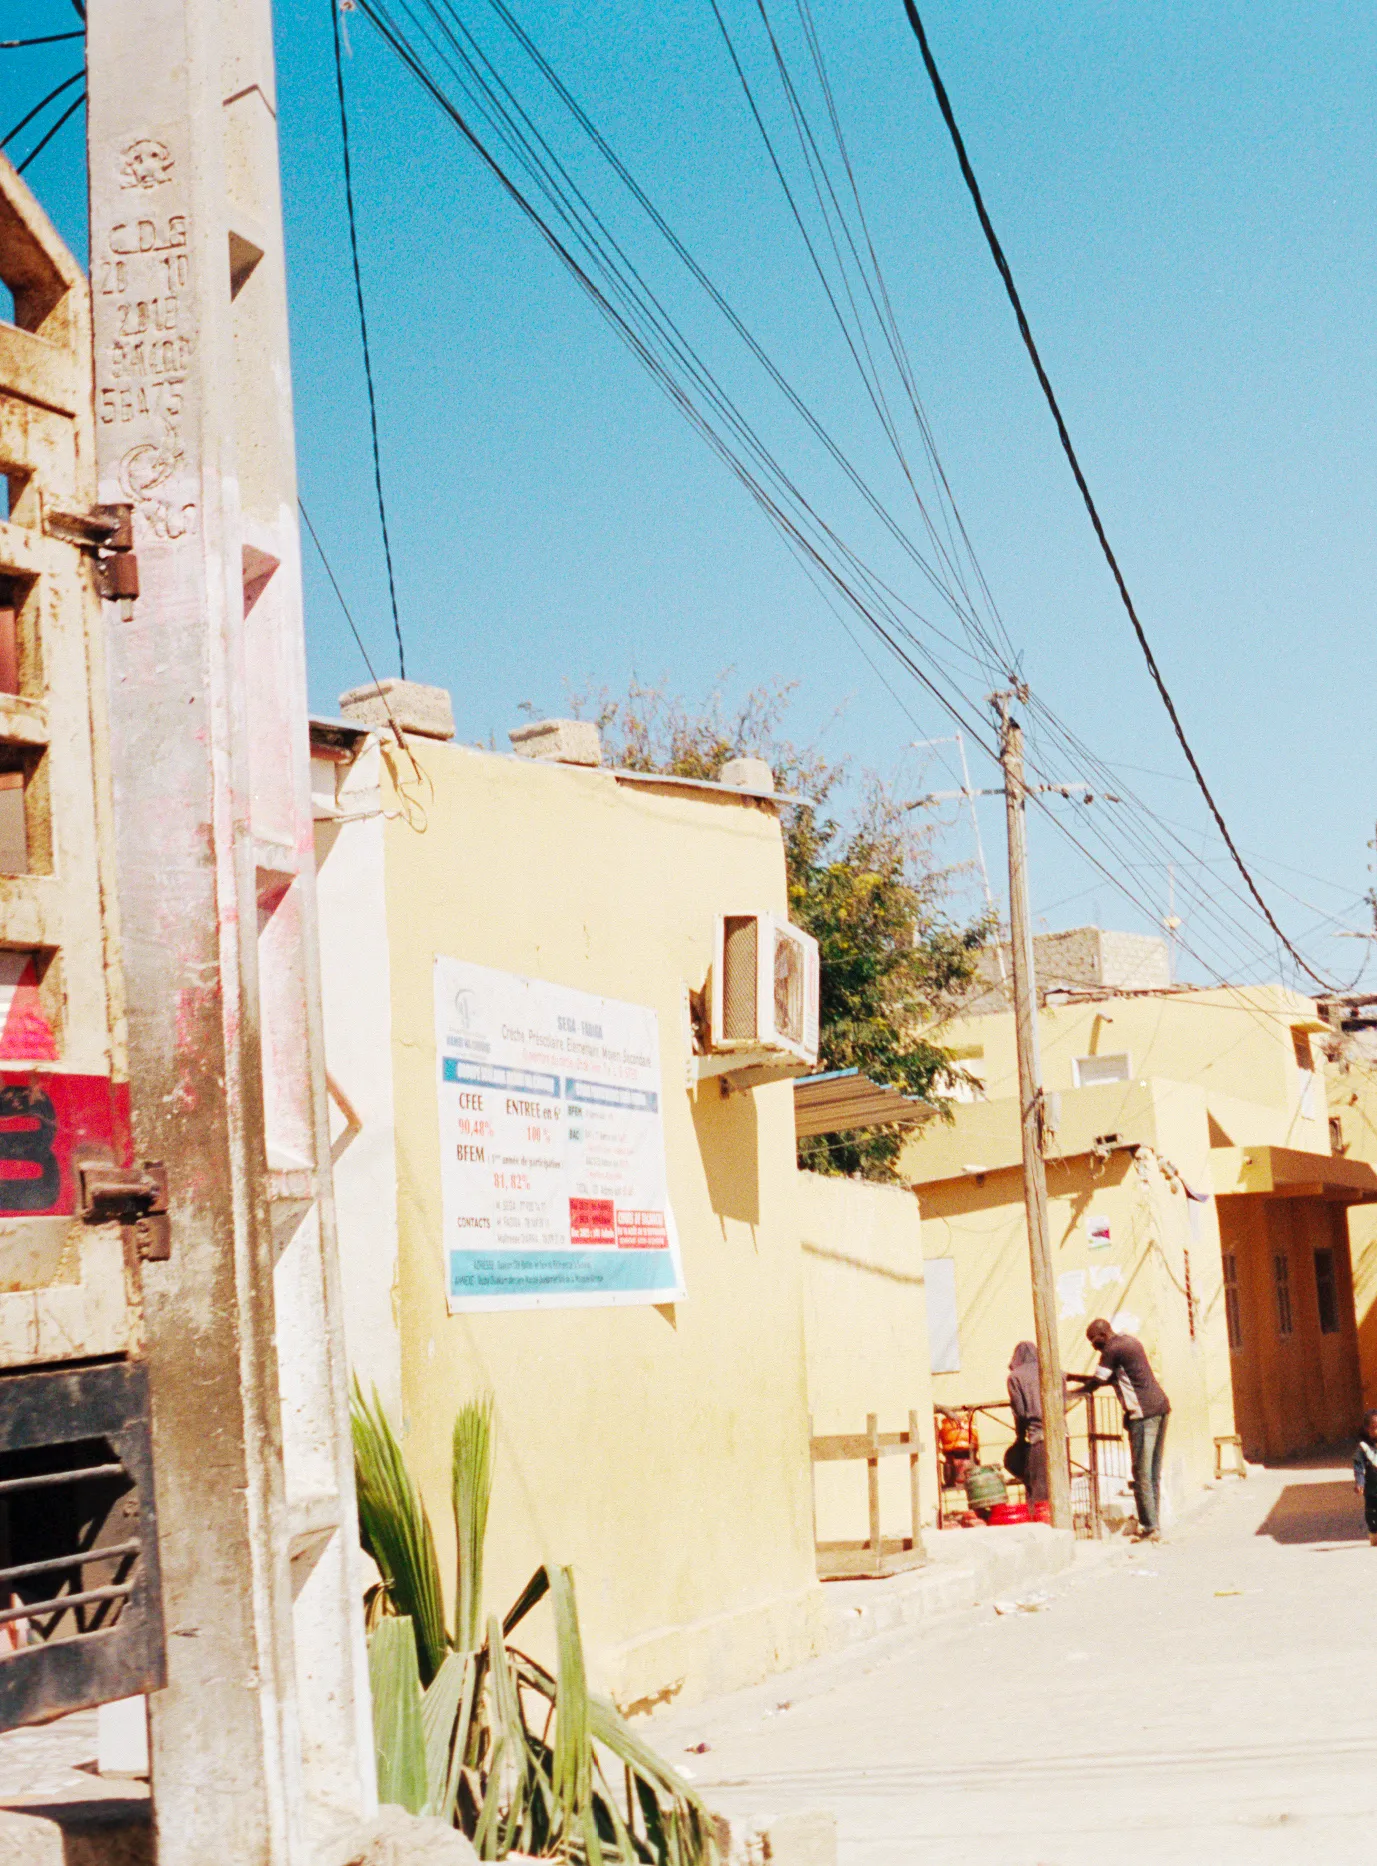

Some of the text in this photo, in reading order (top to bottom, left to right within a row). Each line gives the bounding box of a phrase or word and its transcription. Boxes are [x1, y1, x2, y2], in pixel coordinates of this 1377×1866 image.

[459, 1092, 484, 1111] CFEE
[457, 1144, 485, 1163] BFEM
[457, 1216, 491, 1229] CONTACTS
